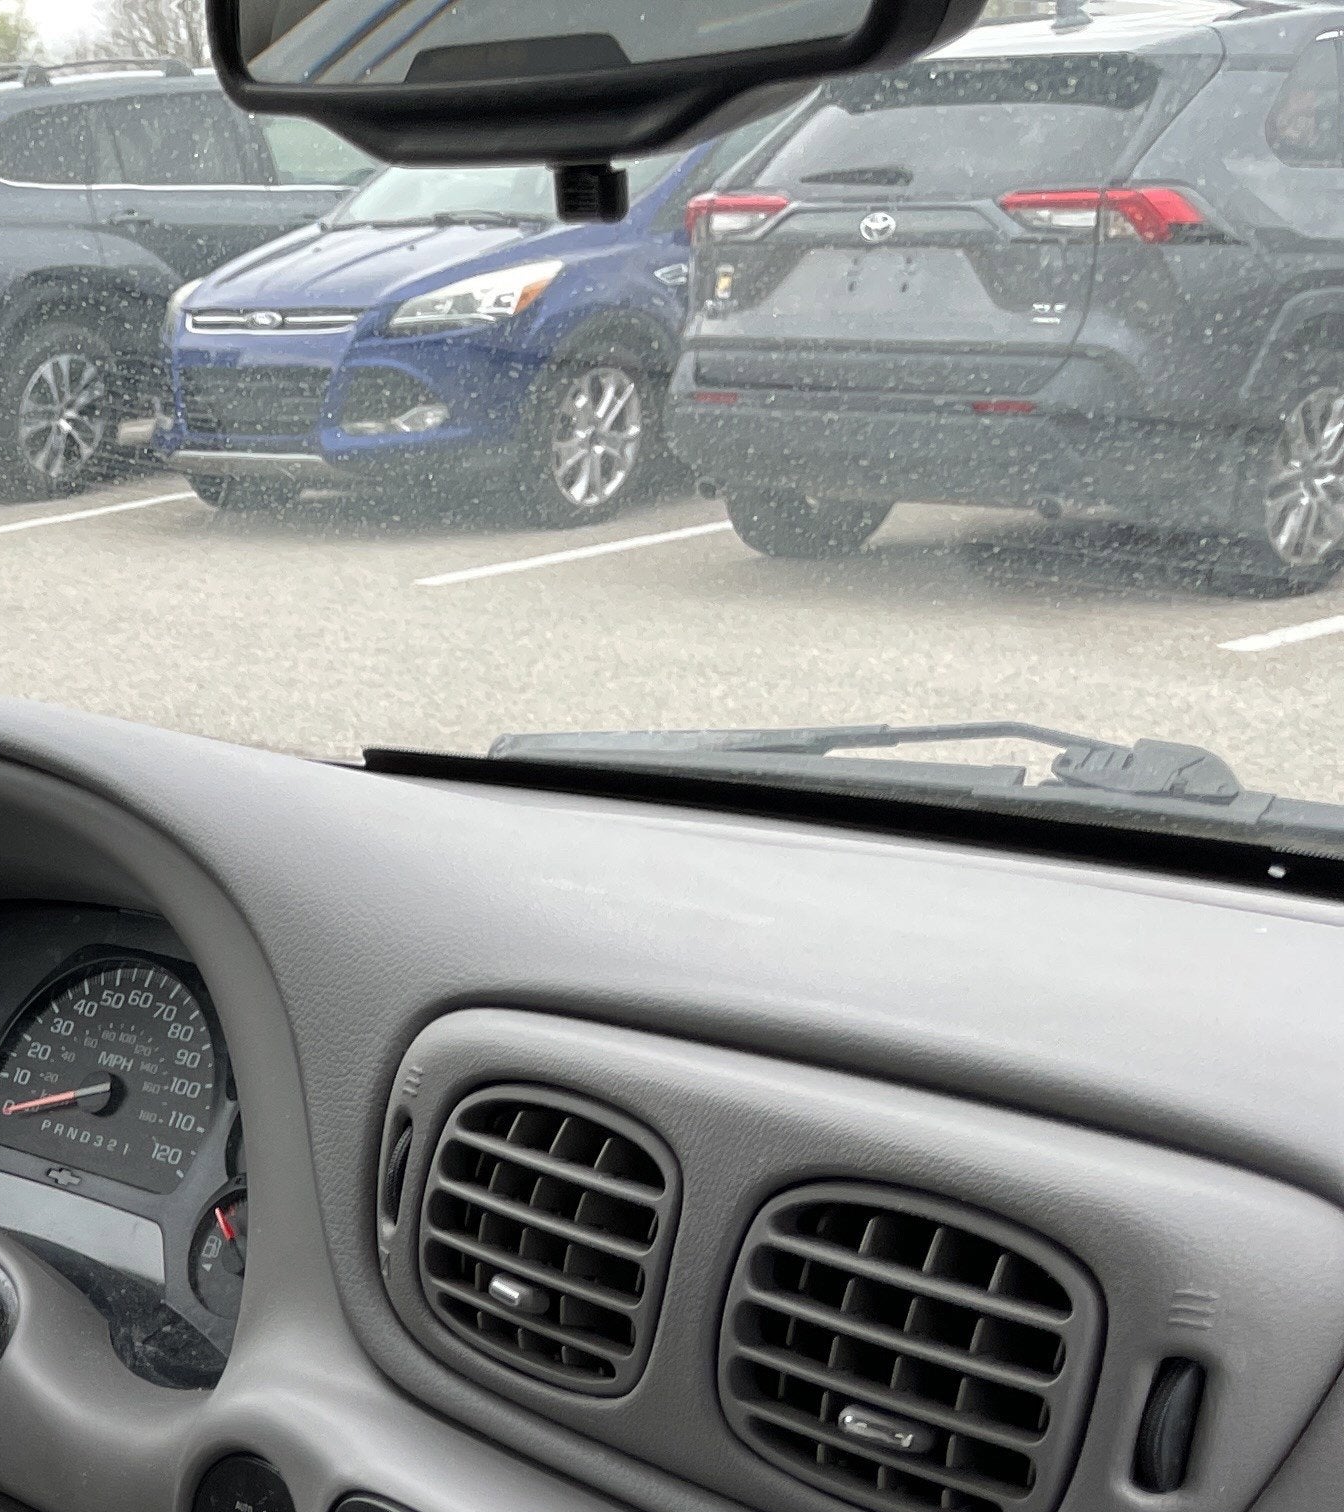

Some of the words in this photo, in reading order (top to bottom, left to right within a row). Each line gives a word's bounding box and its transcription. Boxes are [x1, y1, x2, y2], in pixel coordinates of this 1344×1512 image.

[73, 999, 98, 1017] 40
[100, 990, 125, 1009] 50
[128, 989, 153, 1008] 60
[153, 1002, 178, 1021] 70
[50, 1017, 75, 1036] 30
[167, 1022, 194, 1042] 80
[27, 1041, 52, 1061] 20
[174, 1049, 201, 1068] 90
[97, 1051, 134, 1071] MPH
[13, 1067, 31, 1085] 10
[169, 1076, 202, 1099] 100
[168, 1111, 195, 1132] 110
[151, 1142, 183, 1165] 120
